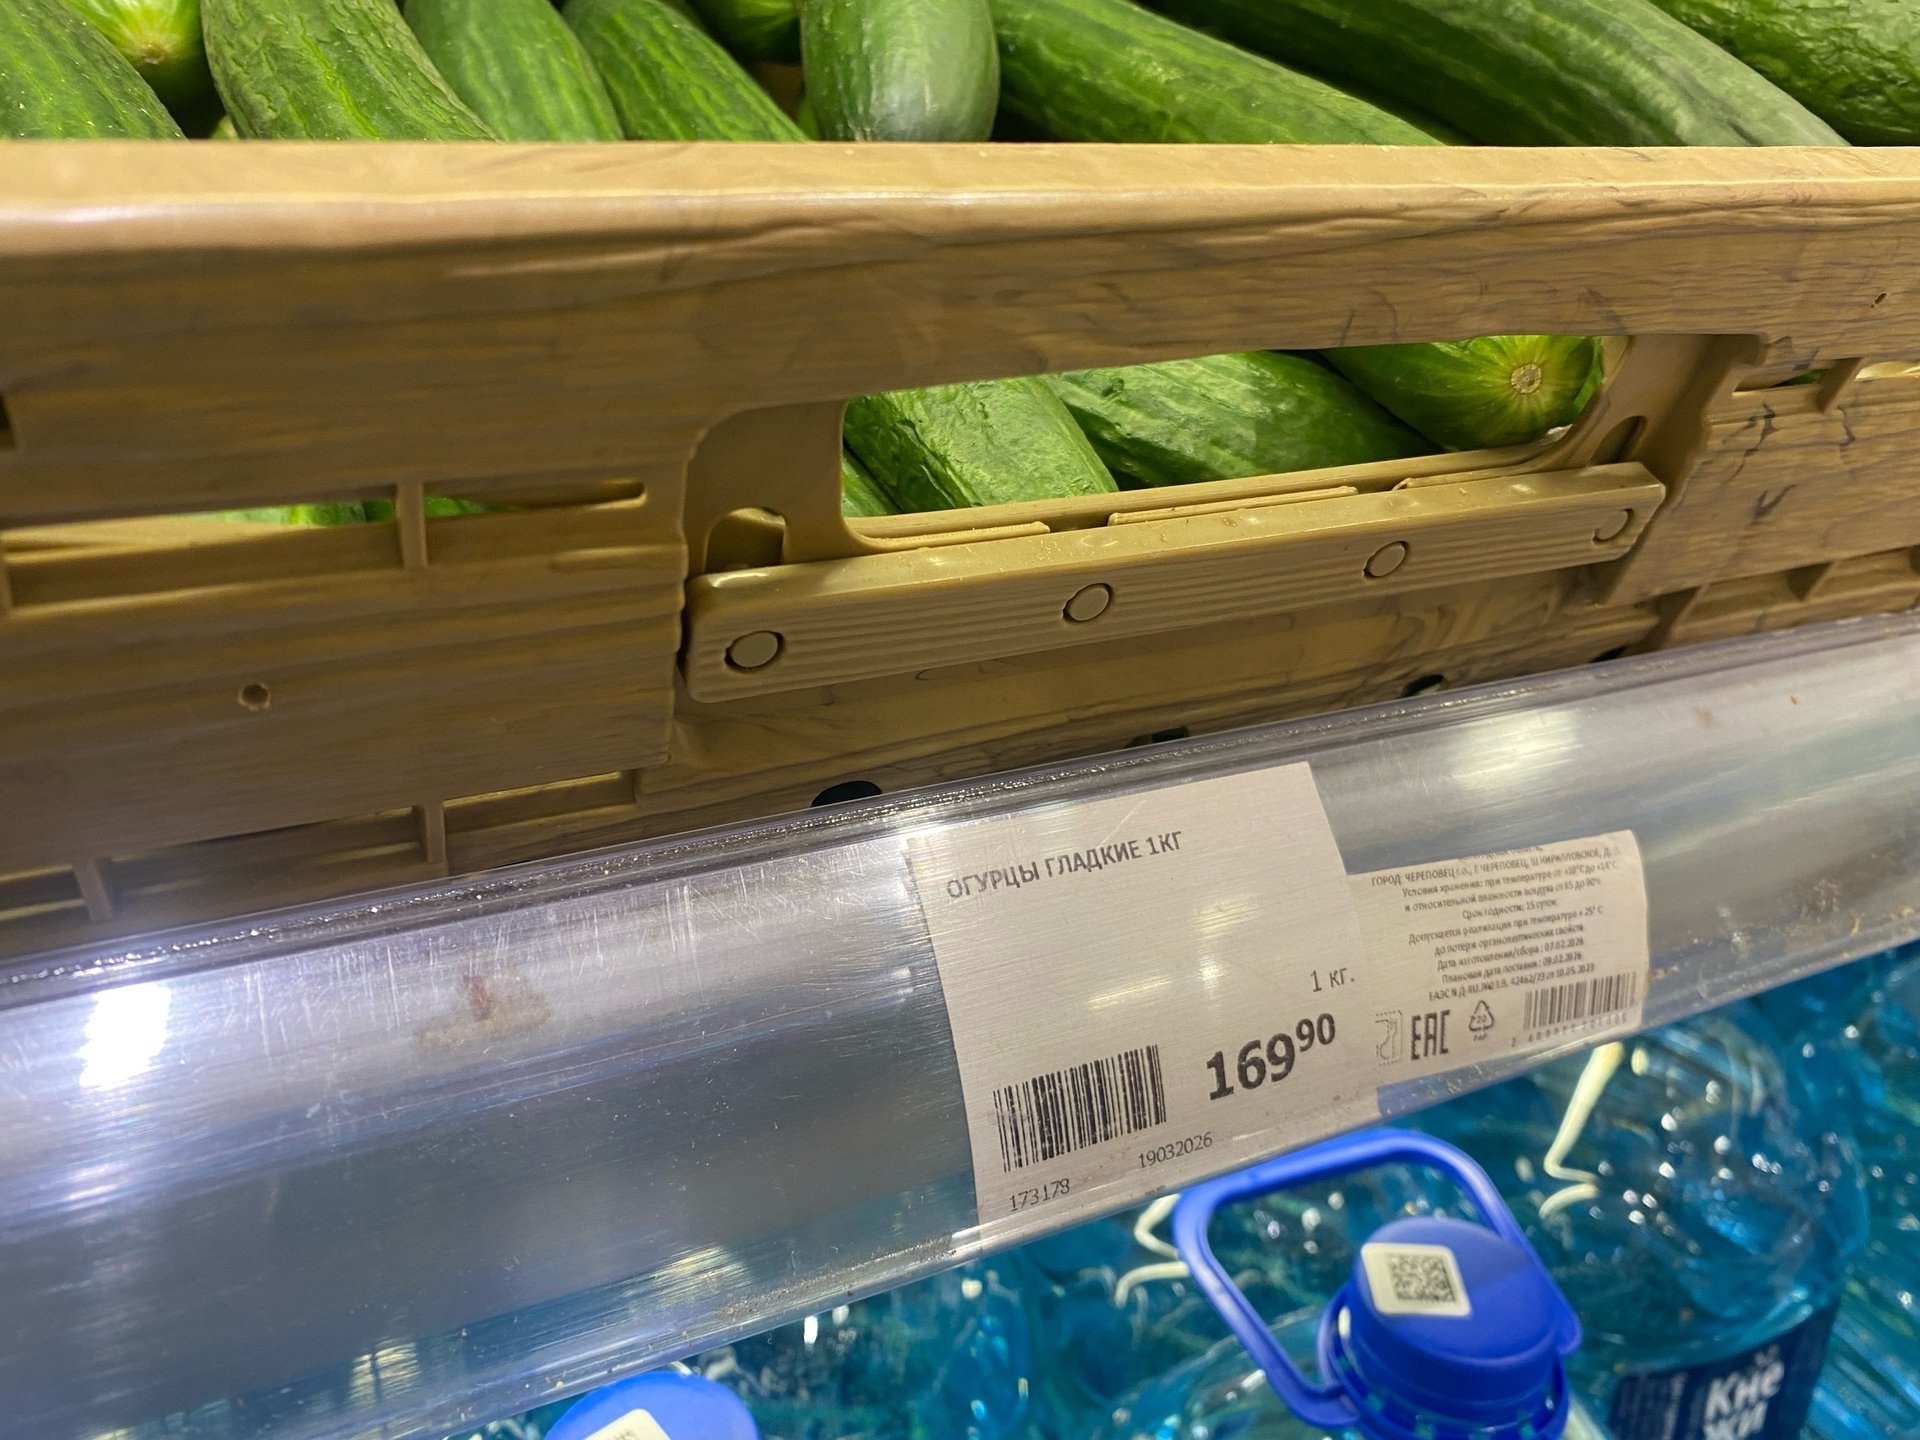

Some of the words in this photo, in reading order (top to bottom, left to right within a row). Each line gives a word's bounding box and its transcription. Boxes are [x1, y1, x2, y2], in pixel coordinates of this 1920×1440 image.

[947, 862, 1040, 898] ОГУРЦЫ
[1045, 840, 1143, 877] ГЛАДКИЕ
[1145, 831, 1182, 856] 1КГ
[1371, 874, 1402, 886] ГОРОД
[1405, 868, 1455, 882] ЧЕРЕПОВЕЦ
[1402, 885, 1438, 897] Условия
[1440, 880, 1482, 894] хранения:
[1485, 878, 1500, 887] при
[1503, 870, 1551, 884] температуре
[1585, 864, 1595, 874] до
[1405, 904, 1410, 912] и
[1412, 894, 1476, 911] относительной
[1478, 890, 1522, 903] влажности
[1524, 885, 1553, 897] воздуха
[1575, 880, 1585, 890] до
[1462, 910, 1483, 920] Срок
[1484, 903, 1524, 917] годности:
[1526, 900, 1535, 909] 15
[1536, 899, 1557, 910] суток
[1409, 928, 1461, 945] Допускается
[1513, 919, 1528, 930] при
[1530, 910, 1577, 924] температуре
[1434, 946, 1446, 957] до
[1447, 941, 1477, 953] потери
[1479, 930, 1555, 949] органолептических
[1555, 923, 1584, 936] свойств
[1437, 960, 1456, 972] Дата
[1458, 945, 1539, 966] изготовления/сбора
[1442, 971, 1482, 984] Плановая
[1483, 966, 1501, 979] дата
[1503, 961, 1537, 974] поставки
[1310, 970, 1322, 992] 1
[1329, 968, 1355, 987] кг.
[1428, 989, 1450, 1001] ЕАЭС
[1138, 1131, 1213, 1168] 19032026
[1009, 1178, 1070, 1212] 173178
